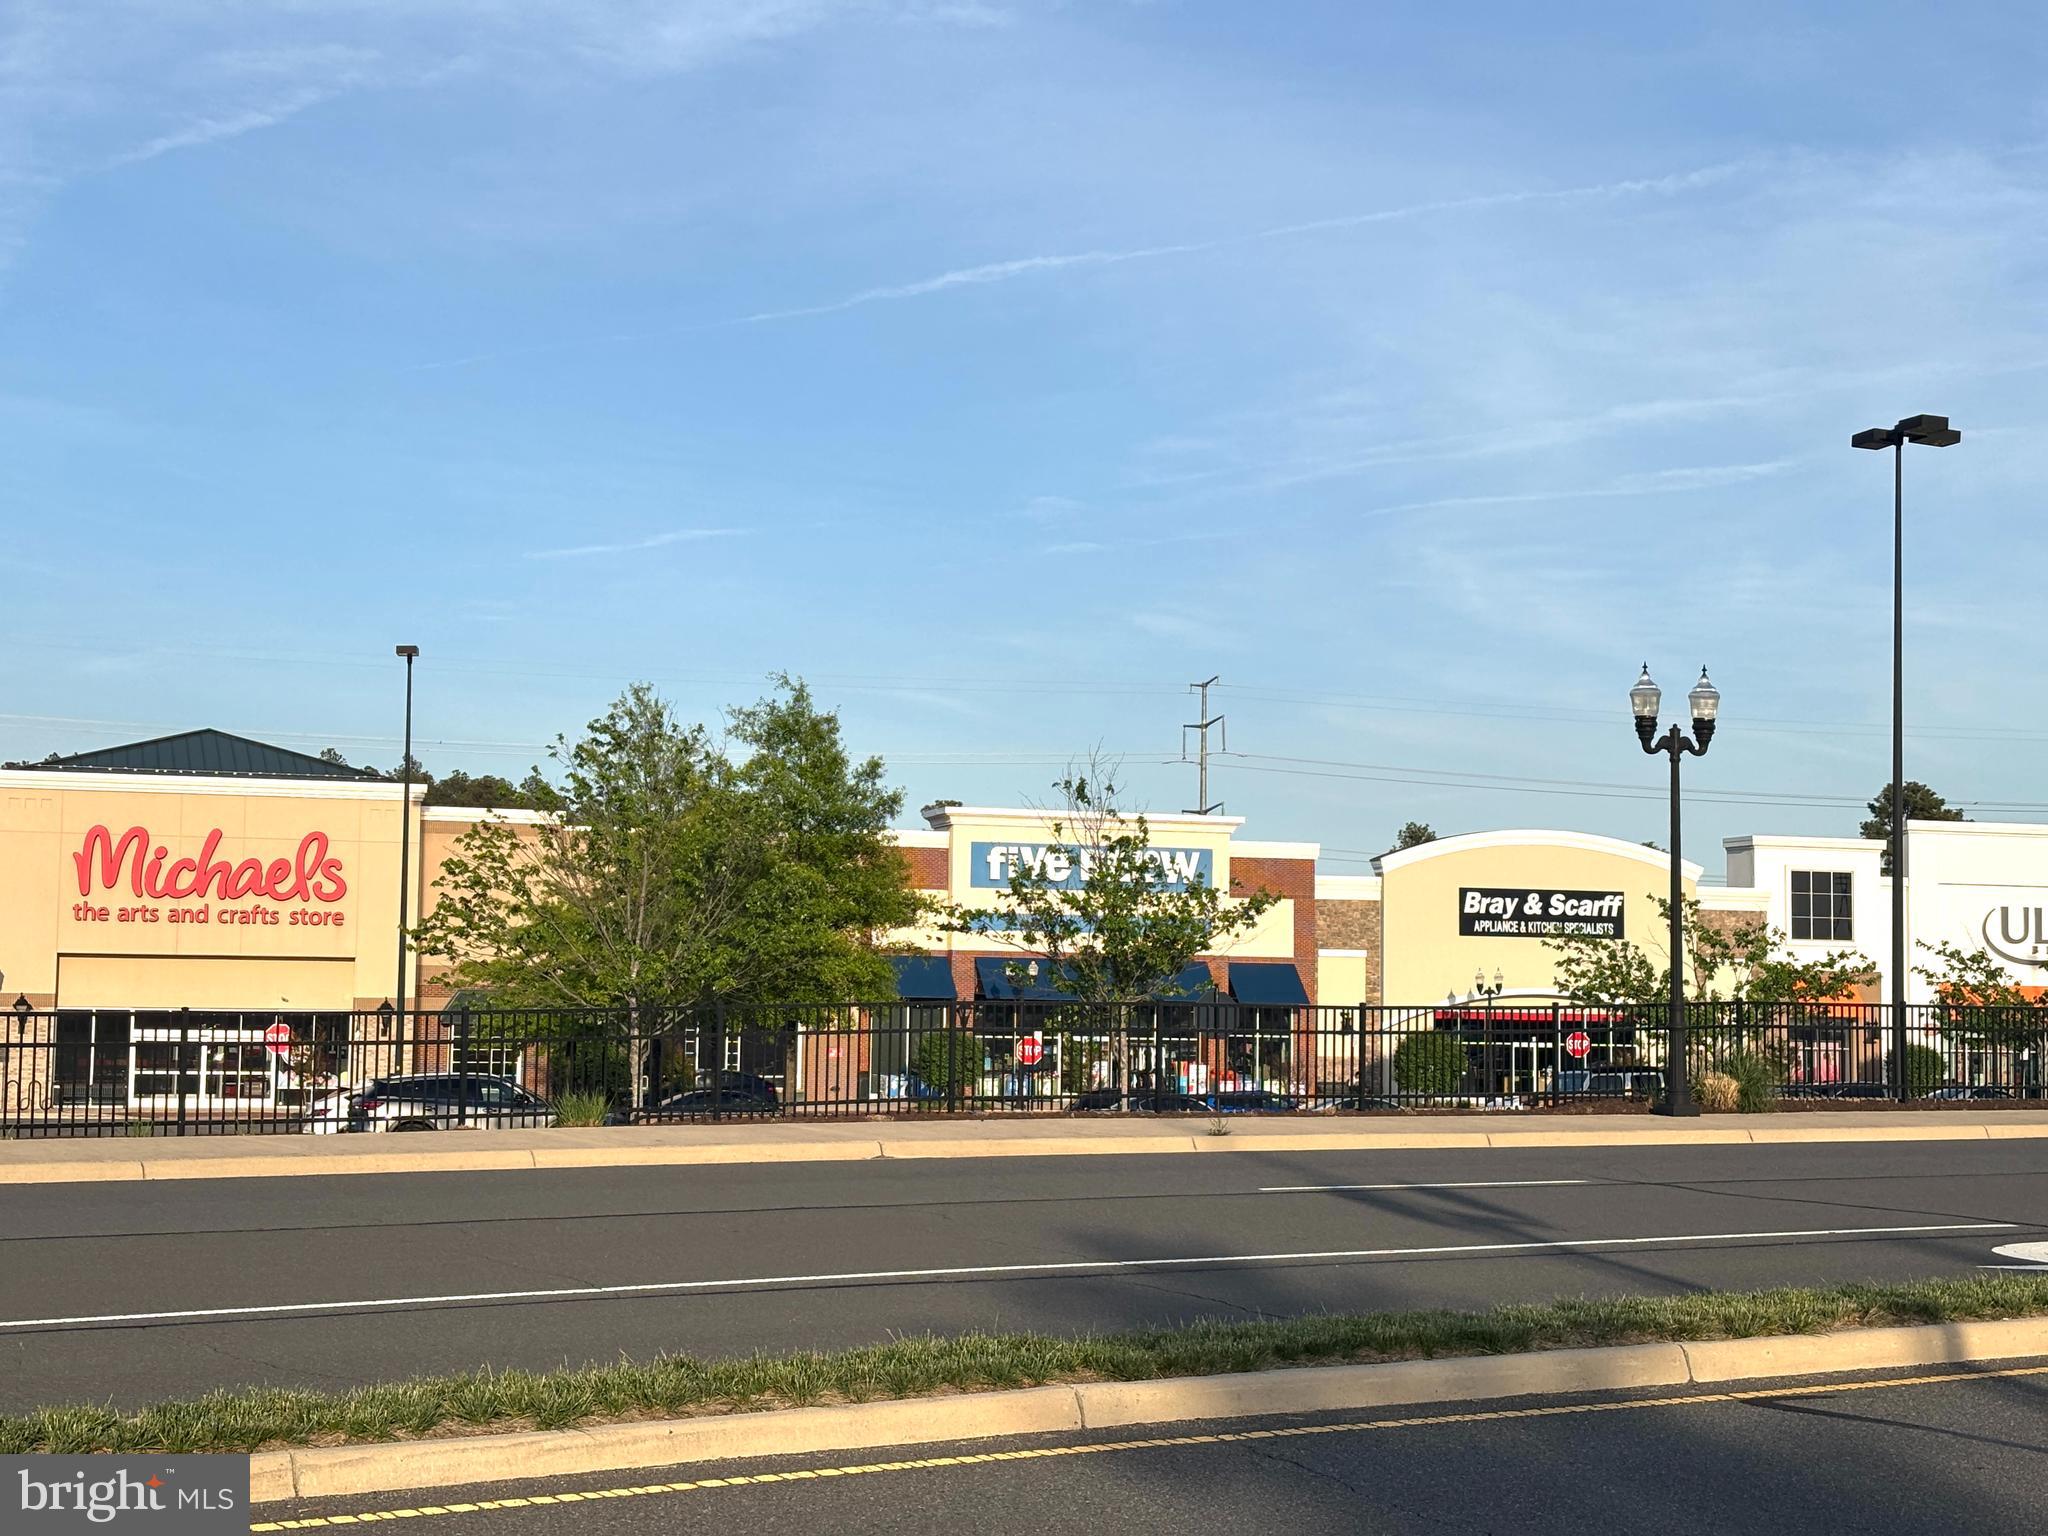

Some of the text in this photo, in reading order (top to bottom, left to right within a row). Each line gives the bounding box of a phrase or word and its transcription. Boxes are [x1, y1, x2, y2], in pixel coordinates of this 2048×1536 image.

[73, 824, 347, 902] Michaels
[987, 845, 1073, 882] five
[73, 901, 345, 927] the arts and crafts store
[1463, 891, 1623, 919] Bray & Scarff
[1474, 920, 1519, 933] APPLIANCE
[1520, 921, 1527, 933] &
[1564, 922, 1615, 936] SPECIALISTS
[1018, 1045, 1042, 1057] STOP
[1568, 1039, 1589, 1050] STOP
